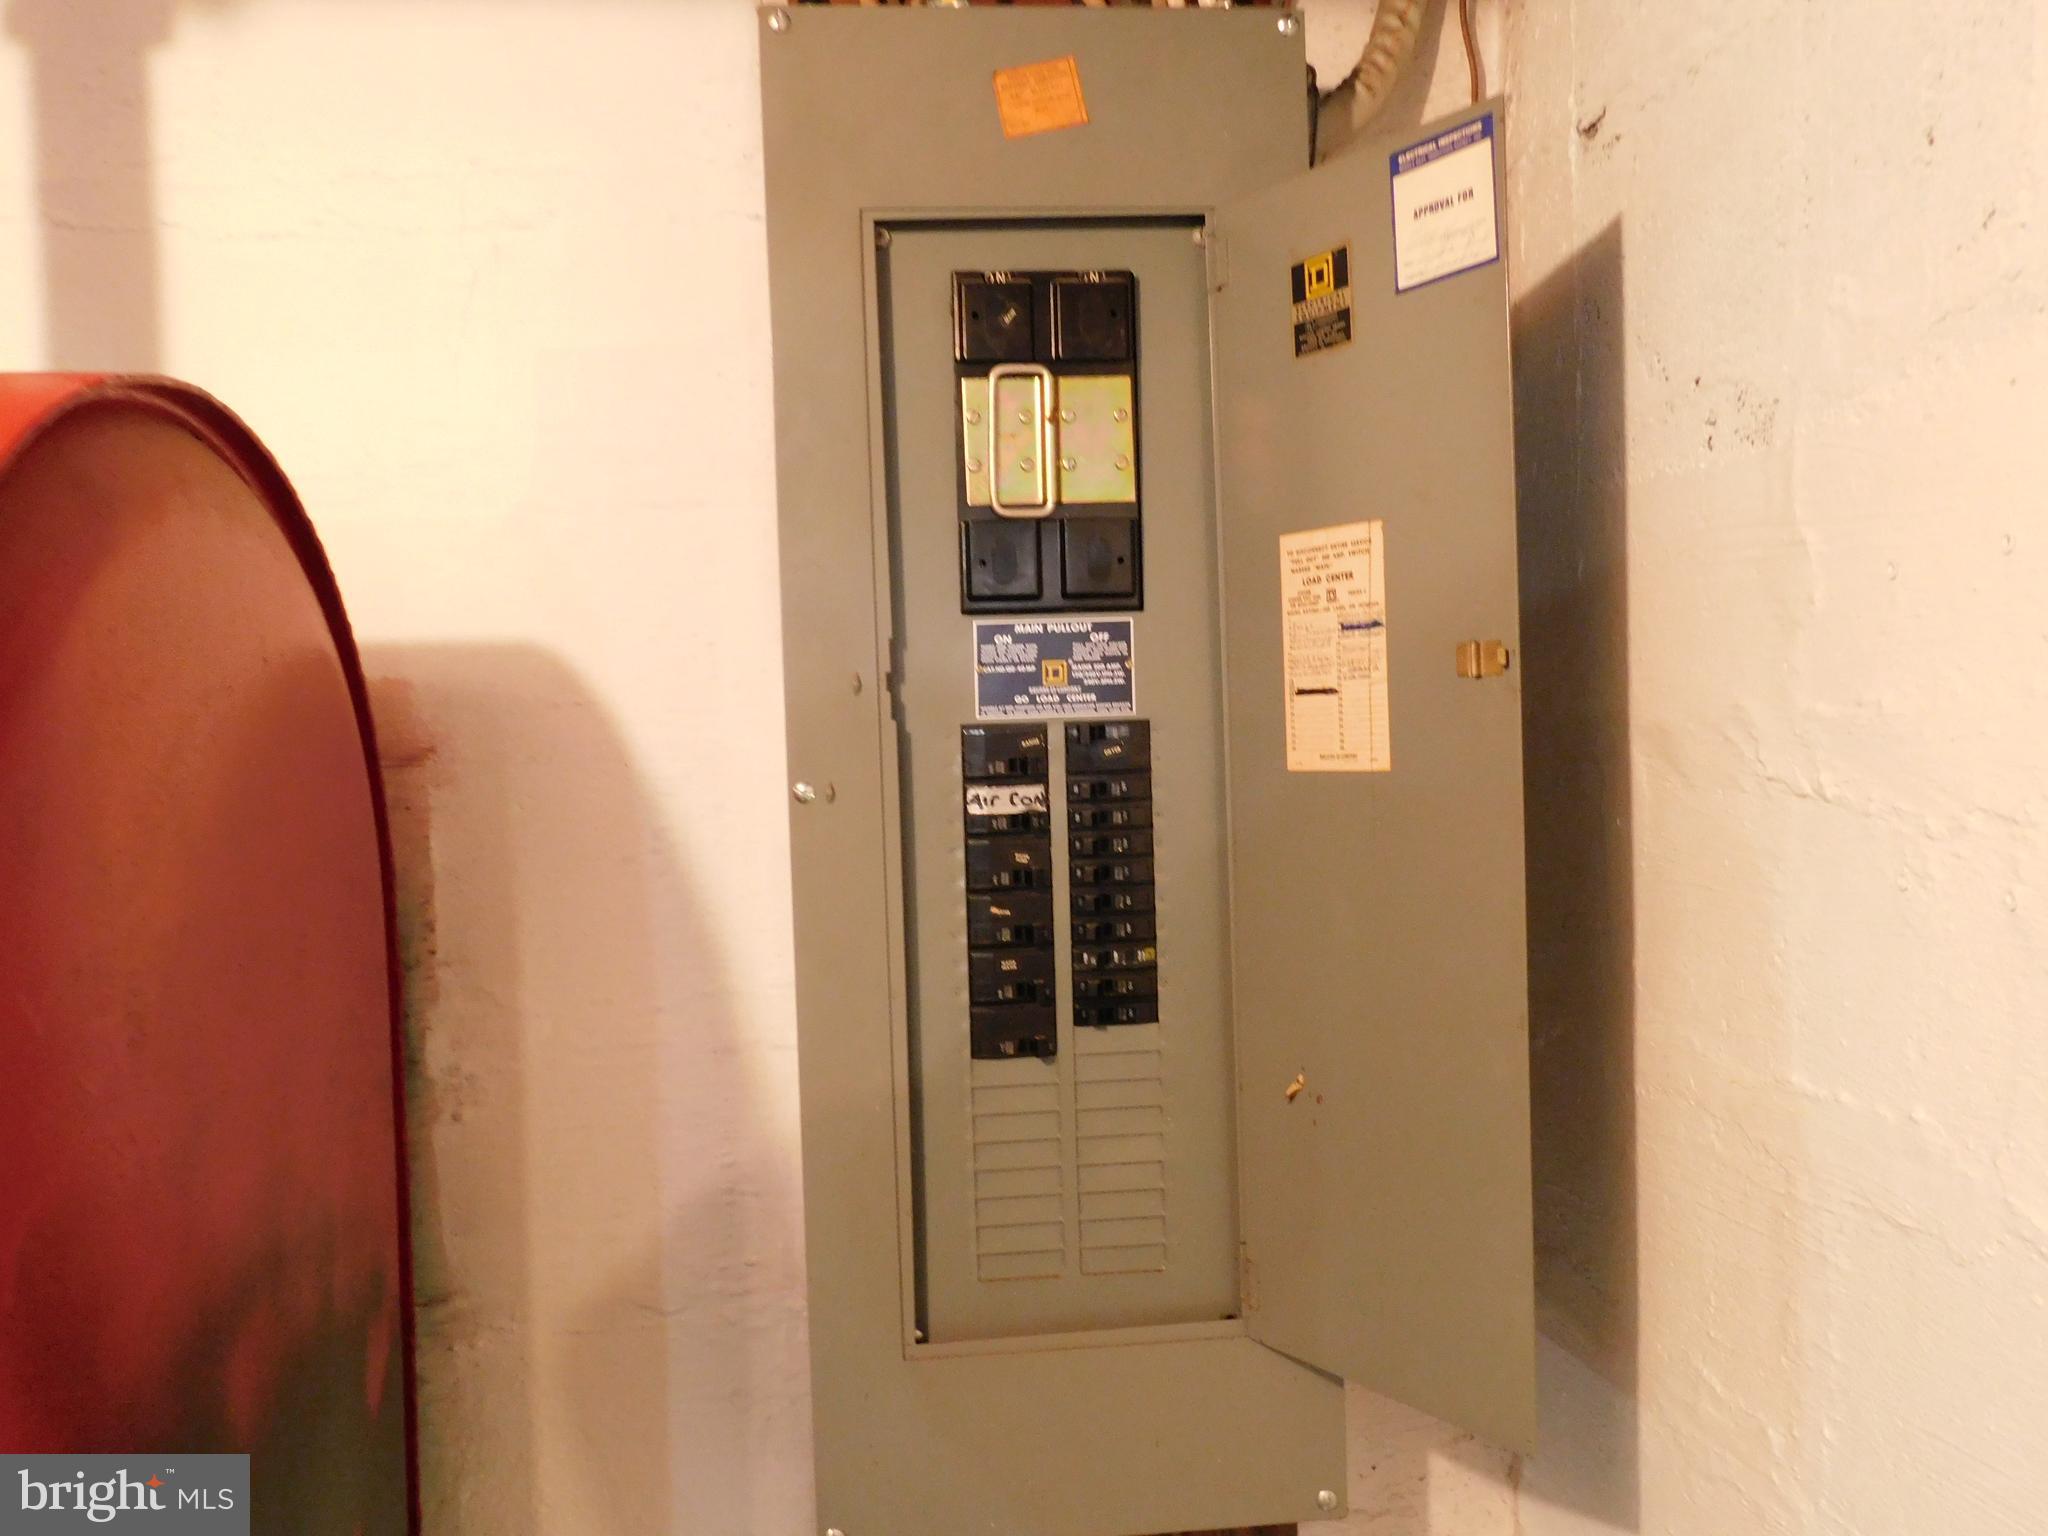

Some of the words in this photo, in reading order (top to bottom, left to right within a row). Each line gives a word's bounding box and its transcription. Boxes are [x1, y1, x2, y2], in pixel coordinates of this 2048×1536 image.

[1413, 195, 1454, 220] APPROVAL
[1457, 186, 1474, 203] FOR
[1302, 575, 1322, 587] LOAD
[1325, 570, 1354, 584] CENTER
[1014, 623, 1044, 635] MAIN
[1046, 622, 1092, 634] PULLOUT
[993, 633, 1012, 644] ON
[1089, 631, 1110, 643] OFF
[1036, 693, 1060, 704] LOAD
[1066, 692, 1097, 703] CENTER
